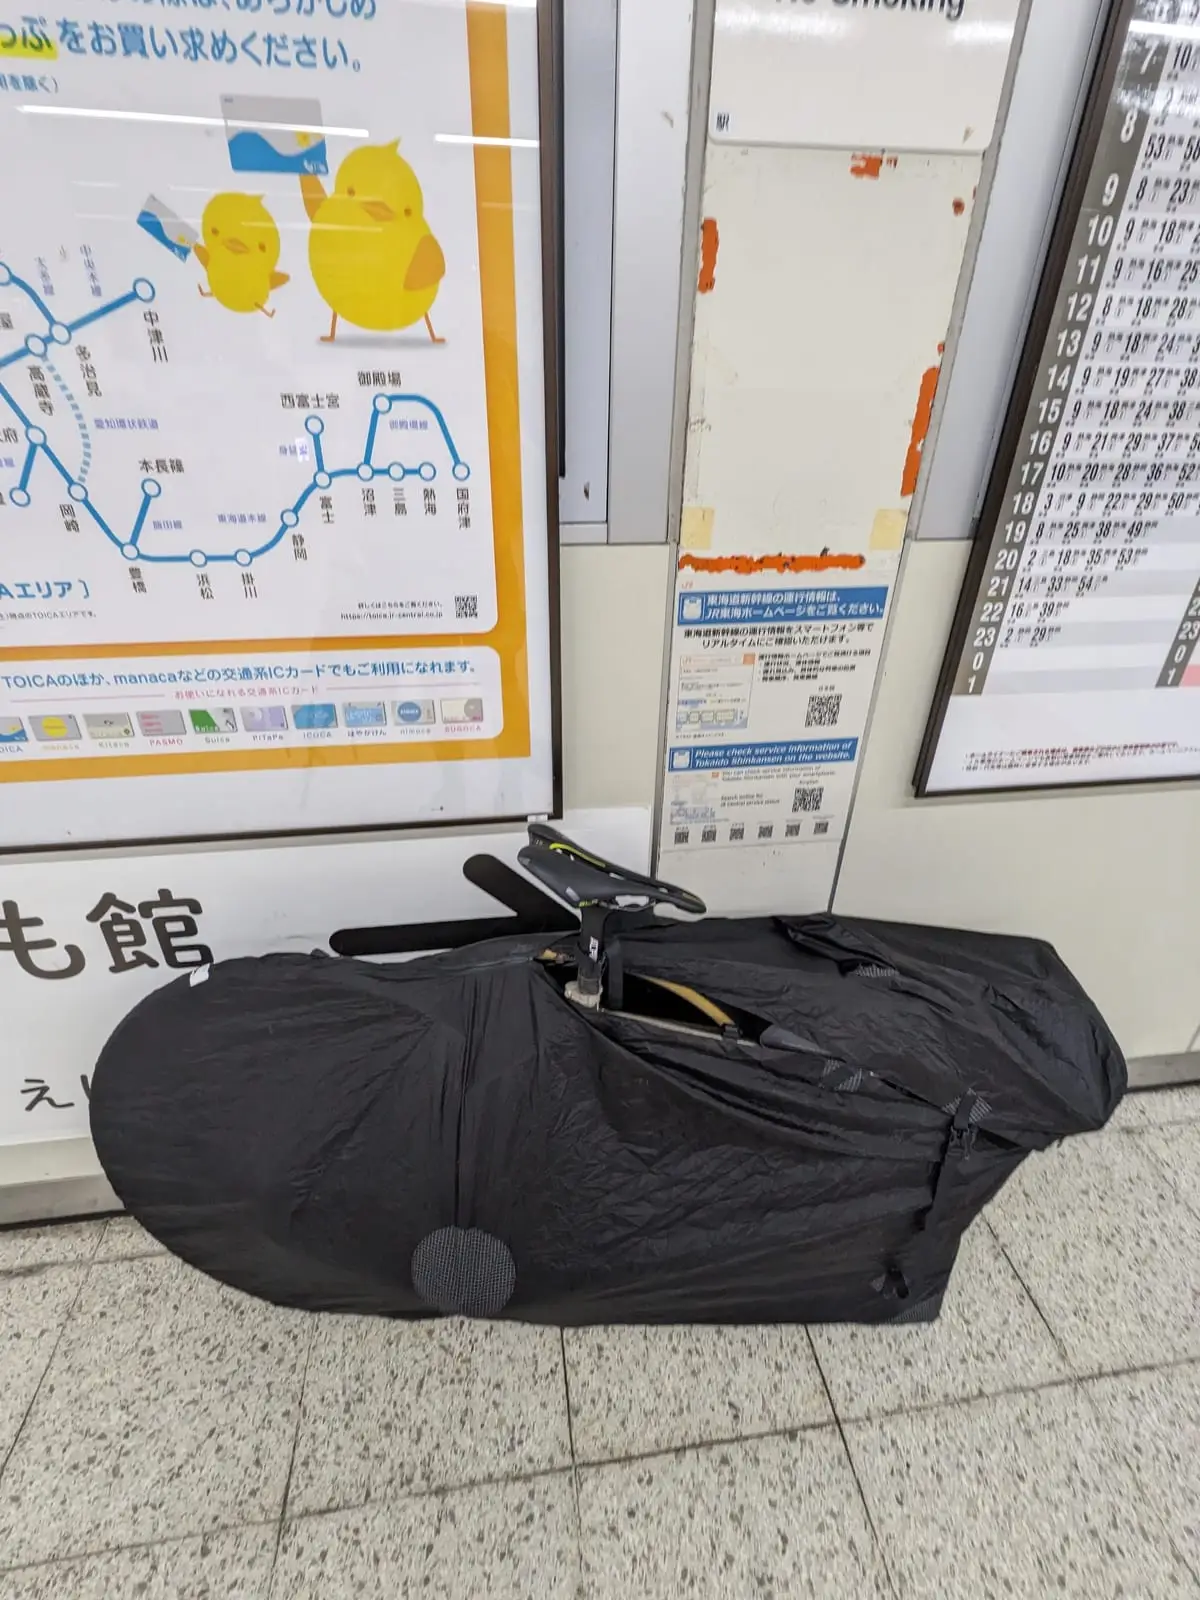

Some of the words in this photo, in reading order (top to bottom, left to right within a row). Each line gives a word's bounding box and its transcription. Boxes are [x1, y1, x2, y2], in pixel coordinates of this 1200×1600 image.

[1173, 43, 1193, 70] 10
[1120, 108, 1137, 143] 8
[1144, 133, 1165, 161] 53
[1102, 173, 1119, 206] 9
[1136, 176, 1148, 201] 8
[1169, 178, 1190, 204] 23
[1087, 215, 1114, 247] 10
[1123, 218, 1135, 244] 9
[1159, 219, 1177, 244] 18
[1076, 254, 1101, 285] 11
[1113, 258, 1124, 281] 9
[1147, 258, 1165, 282] 16
[1180, 259, 1198, 283] 25
[1067, 292, 1092, 321] 12
[1102, 295, 1113, 317] 8
[1136, 297, 1153, 319] 18
[1168, 297, 1188, 319] 28
[143, 309, 168, 362] 中津川
[1057, 329, 1082, 357] 13
[1091, 332, 1102, 352] 9
[1124, 332, 1141, 353] 18
[1157, 333, 1176, 353] 24
[1047, 364, 1071, 391] 14
[1082, 366, 1092, 387] 9
[1114, 366, 1130, 387] 19
[1146, 367, 1164, 388] 27
[1180, 367, 1198, 388] 38
[279, 392, 340, 409] 西富士宮
[1038, 398, 1062, 424] 15
[1072, 399, 1082, 420] 9
[1103, 400, 1120, 420] 18
[1135, 400, 1151, 420] 24
[1168, 400, 1186, 420] 38
[1029, 430, 1052, 456] 16
[1061, 432, 1072, 450] 9
[1091, 432, 1108, 451] 21
[1124, 432, 1143, 451] 29
[1157, 432, 1175, 451] 37
[1021, 461, 1044, 486] 17
[1050, 463, 1066, 481] 10
[1081, 463, 1099, 481] 20
[1114, 463, 1131, 481] 28
[1146, 463, 1162, 481] 36
[1178, 463, 1196, 481] 52
[319, 496, 334, 524] 富士
[362, 487, 377, 516] 沼津
[393, 487, 407, 516] 三島
[1012, 491, 1035, 515] 18
[1043, 492, 1053, 511] 3
[1076, 492, 1086, 511] 9
[1104, 492, 1121, 511] 22
[1136, 492, 1153, 511] 29
[1167, 492, 1185, 511] 50
[1004, 520, 1027, 544] 19
[1035, 521, 1045, 538] 8
[1063, 521, 1079, 538] 25
[1095, 521, 1111, 538] 38
[1127, 521, 1143, 538] 49
[994, 549, 1018, 570] 20
[1027, 550, 1037, 566] 2
[1057, 549, 1071, 566] 18
[1087, 549, 1101, 566] 35
[1117, 549, 1133, 566] 53
[987, 576, 1009, 597] 21
[1017, 576, 1031, 593] 14
[1047, 576, 1064, 593] 33
[1077, 575, 1094, 592] 54
[980, 602, 1003, 622] 22
[1010, 602, 1023, 618] 16
[1038, 602, 1055, 618] 39
[973, 627, 996, 647] 23
[1004, 628, 1014, 643] 2
[1030, 627, 1047, 642] 29
[1178, 620, 1200, 640] 23
[972, 652, 984, 671] 0
[1174, 645, 1187, 663] 0
[967, 675, 977, 694] 1
[1167, 667, 1177, 685] 1
[149, 738, 184, 747] PASMO
[695, 749, 725, 758] Please
[726, 747, 752, 757] check
[754, 746, 785, 755] service
[788, 742, 841, 753] information
[842, 740, 853, 750] of
[695, 758, 729, 768] Tokaido
[731, 755, 783, 767] Shinkansen
[798, 752, 813, 761] the
